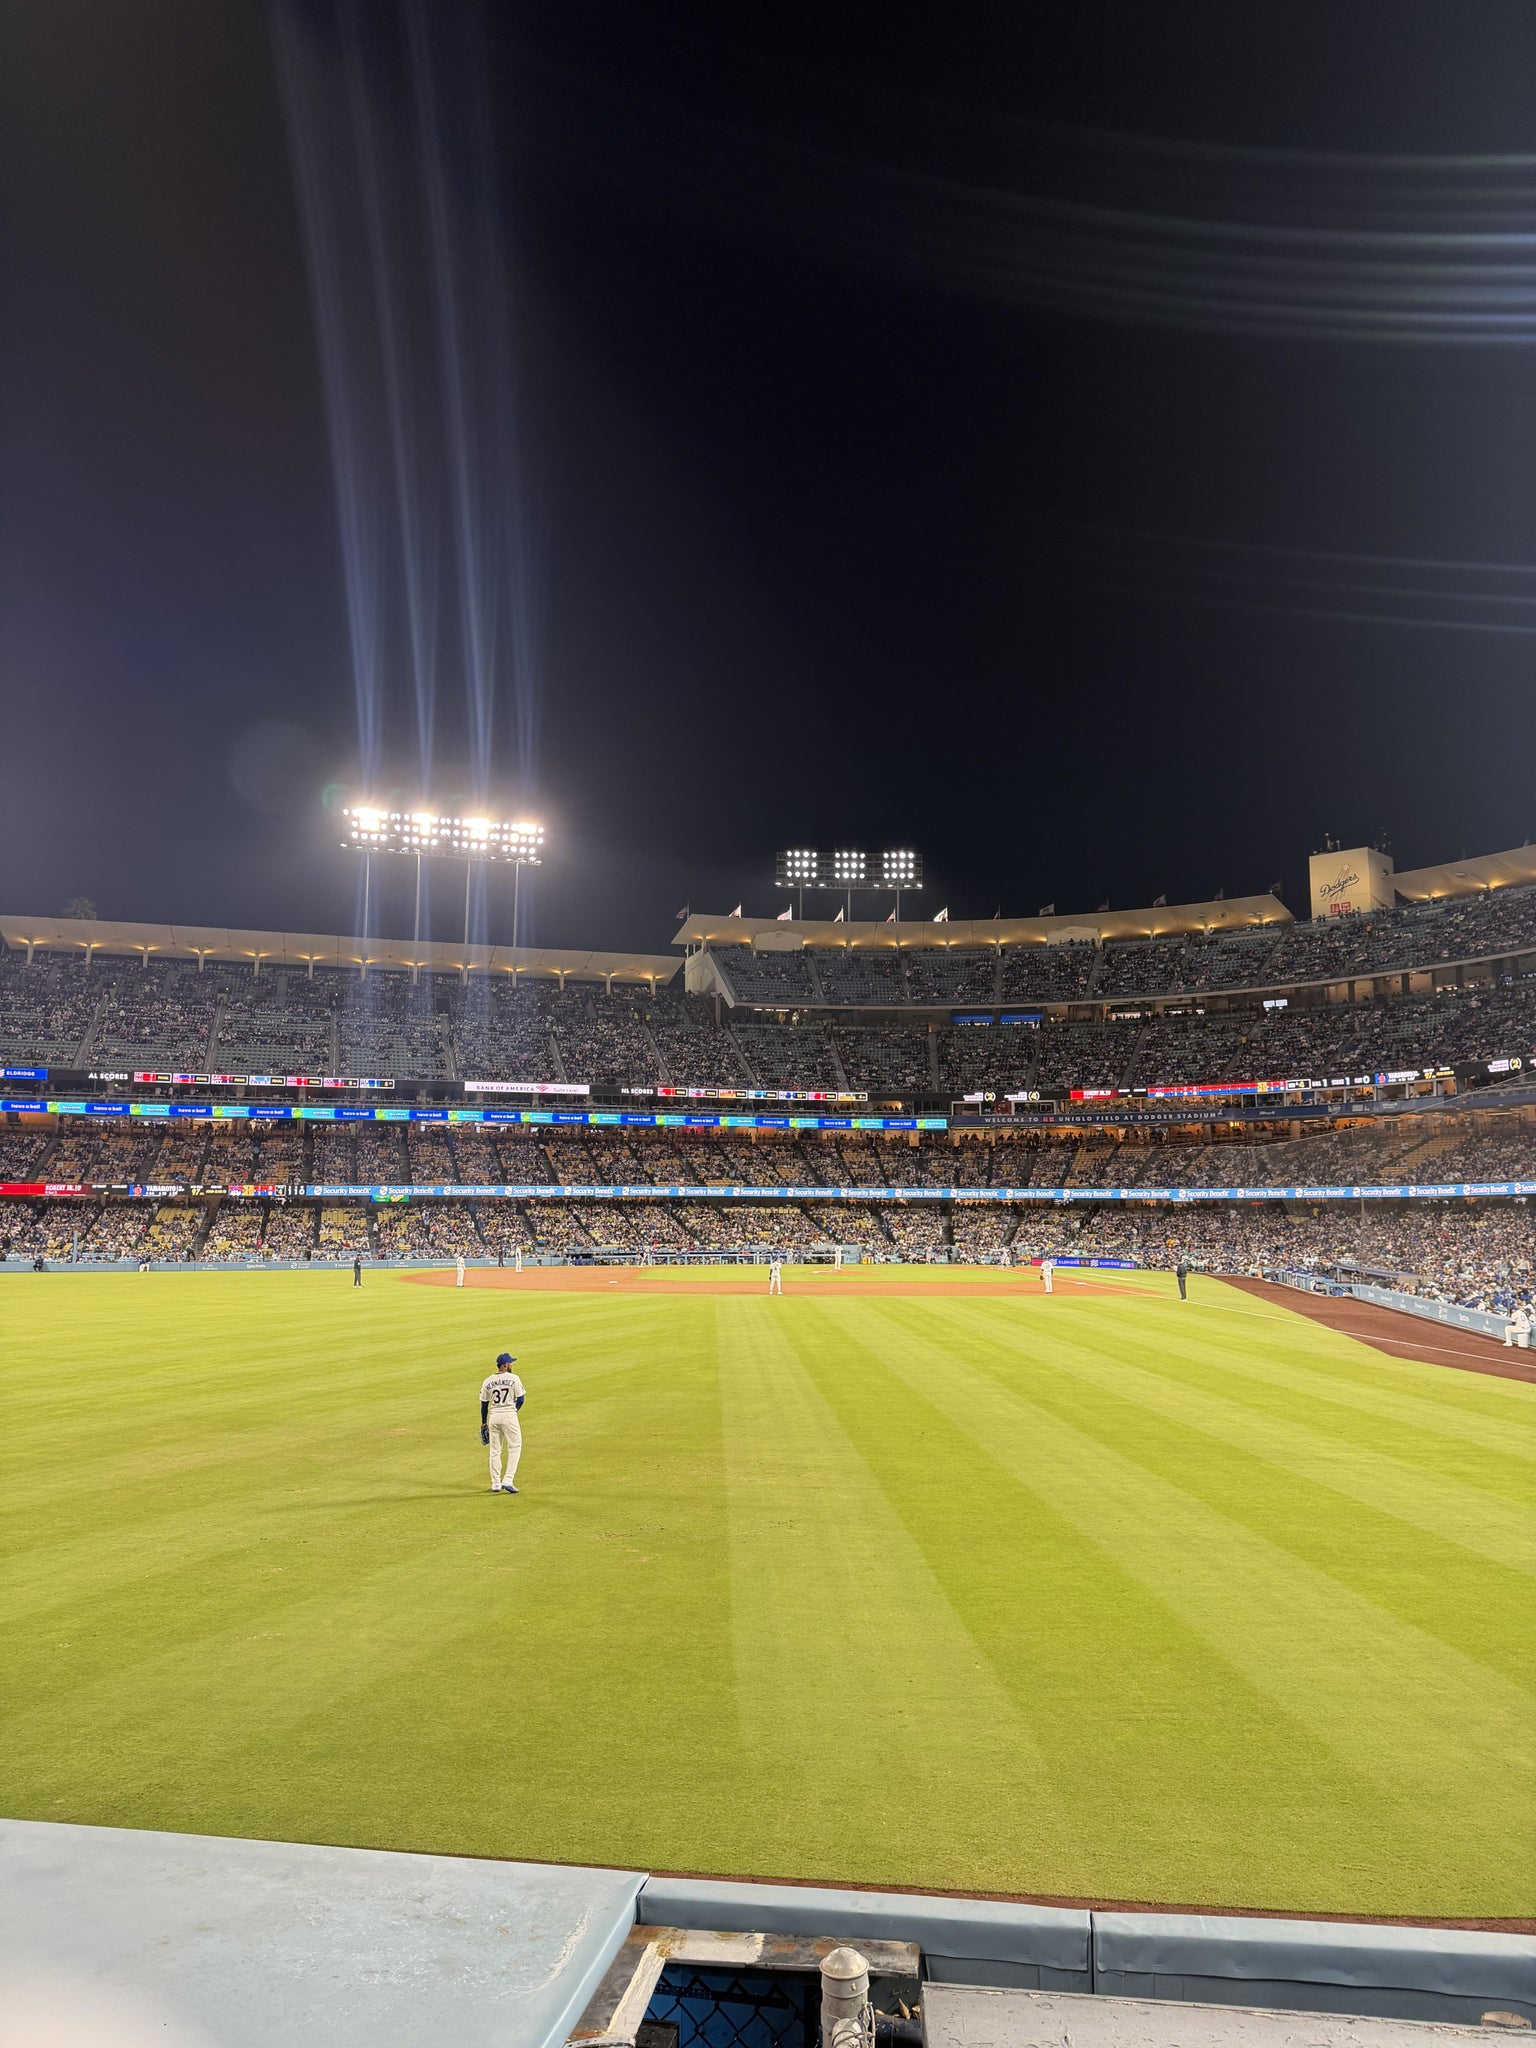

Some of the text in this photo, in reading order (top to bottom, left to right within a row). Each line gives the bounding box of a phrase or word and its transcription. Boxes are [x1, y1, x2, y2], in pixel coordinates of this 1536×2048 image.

[1320, 874, 1359, 897] Dodgers
[100, 1072, 128, 1080] SCORES
[323, 1187, 346, 1195] Security
[389, 1187, 412, 1195] Security
[452, 1187, 474, 1195] Security
[514, 1187, 534, 1195] Security
[573, 1187, 594, 1195] Security
[795, 1189, 814, 1197] Security
[902, 1190, 922, 1198] Security
[958, 1190, 978, 1198] Security
[1014, 1190, 1034, 1198] Security
[1071, 1190, 1092, 1198] Security
[1129, 1190, 1150, 1198] Security
[1187, 1190, 1208, 1198] Security
[1246, 1190, 1266, 1198] Security
[1303, 1189, 1324, 1197] Security
[1417, 1187, 1436, 1195] Security
[1470, 1186, 1489, 1194] Security
[492, 1388, 509, 1404] 37
